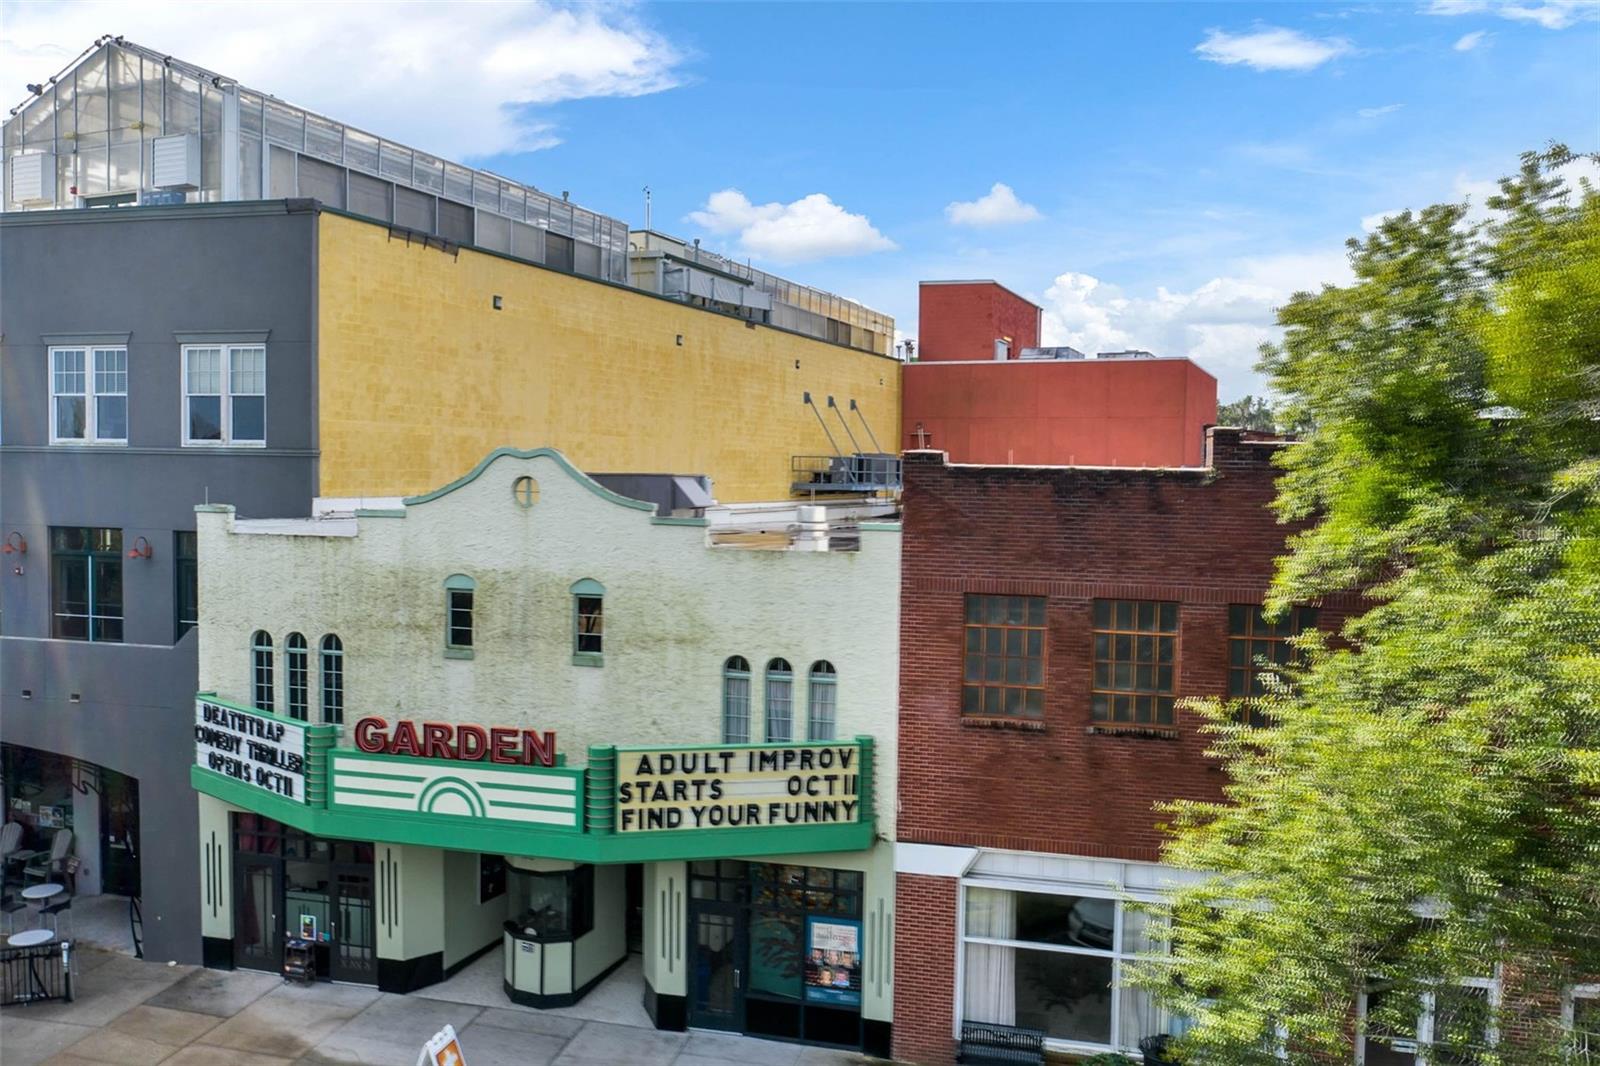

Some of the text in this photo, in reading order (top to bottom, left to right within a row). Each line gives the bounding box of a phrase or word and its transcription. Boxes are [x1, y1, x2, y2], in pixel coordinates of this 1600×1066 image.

[203, 703, 285, 743] DEATHTRAP
[194, 724, 242, 755] COMEDY
[354, 716, 557, 767] GARDEN
[208, 751, 251, 782] OPENS
[636, 748, 854, 776] ADULT IMPROV
[619, 778, 724, 803] STARTS
[621, 800, 858, 831] FIND YOUR FUNNY
